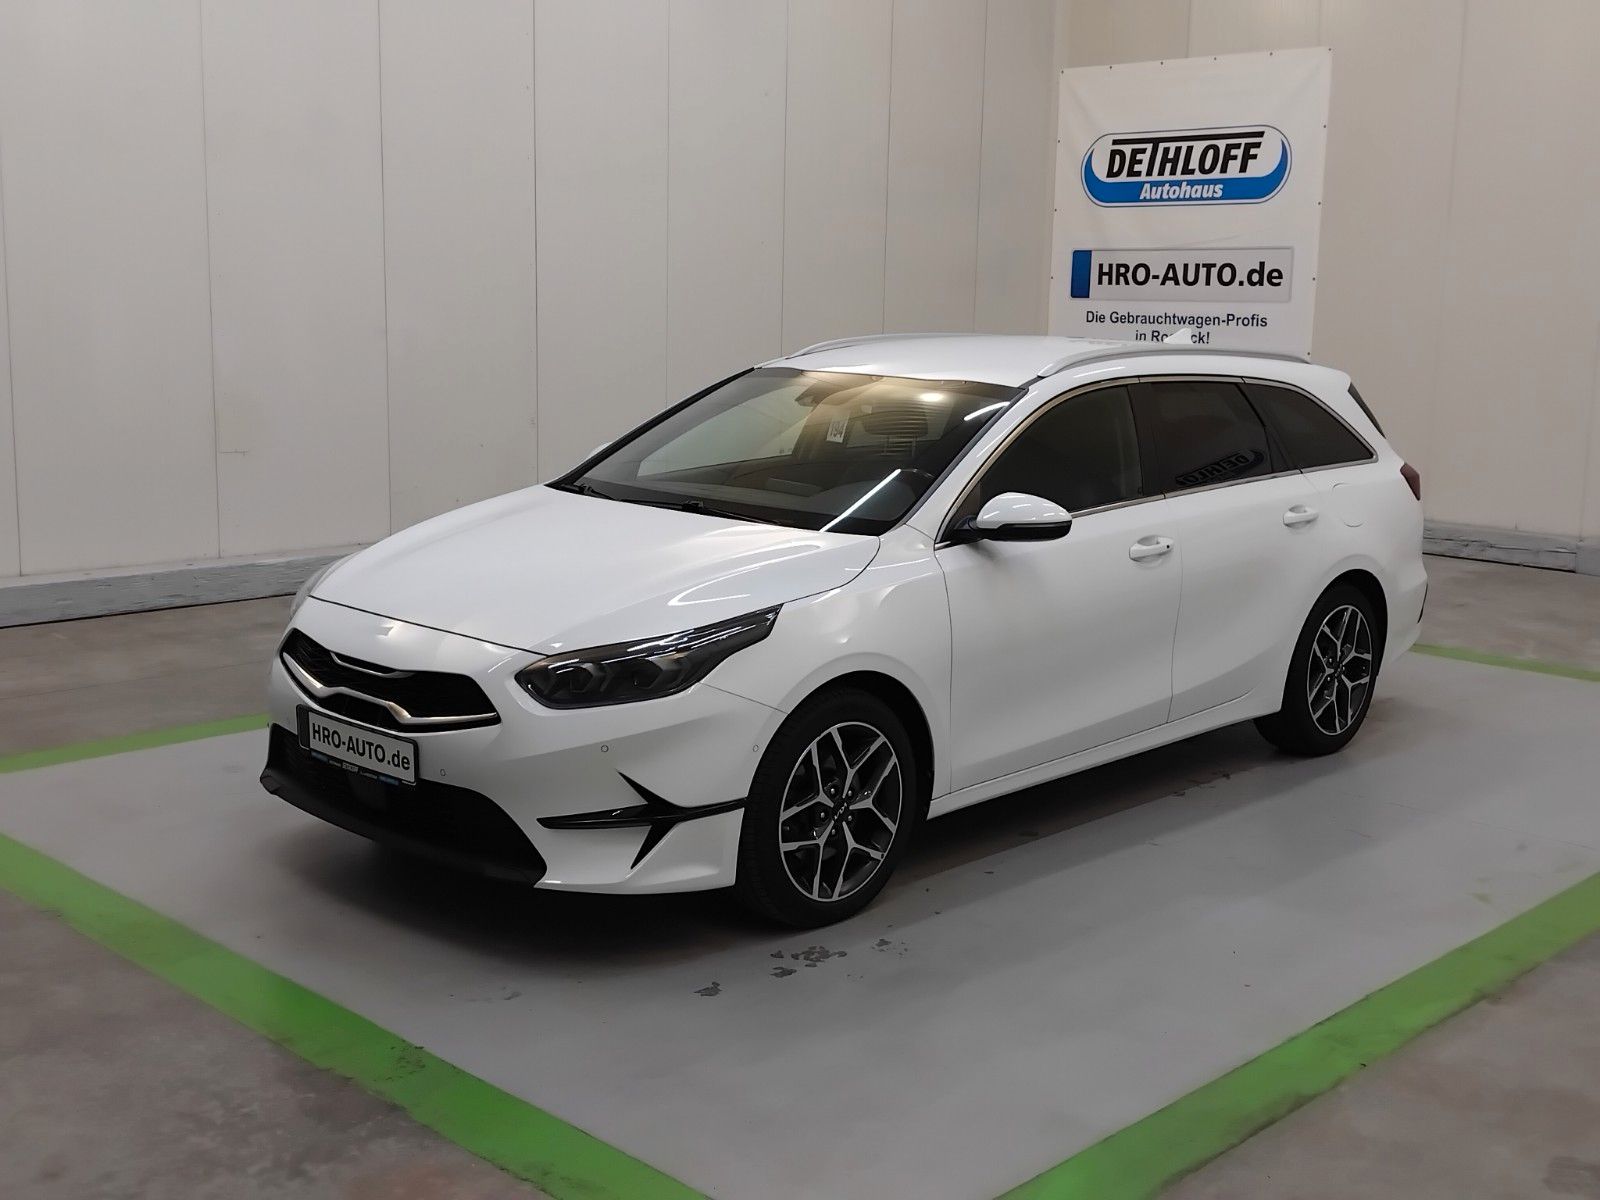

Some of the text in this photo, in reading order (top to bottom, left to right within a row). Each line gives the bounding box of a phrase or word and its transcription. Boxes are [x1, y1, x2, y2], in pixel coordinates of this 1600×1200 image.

[1106, 131, 1265, 178] DETHLOFF
[1140, 181, 1223, 200] Autohaus
[1097, 261, 1284, 287] HRO-AUTO.de
[1086, 311, 1268, 329] Die Gebrauchtwagen-Profis
[1135, 330, 1210, 345] in Rock!
[312, 723, 411, 771] HRO-AUTO.de
